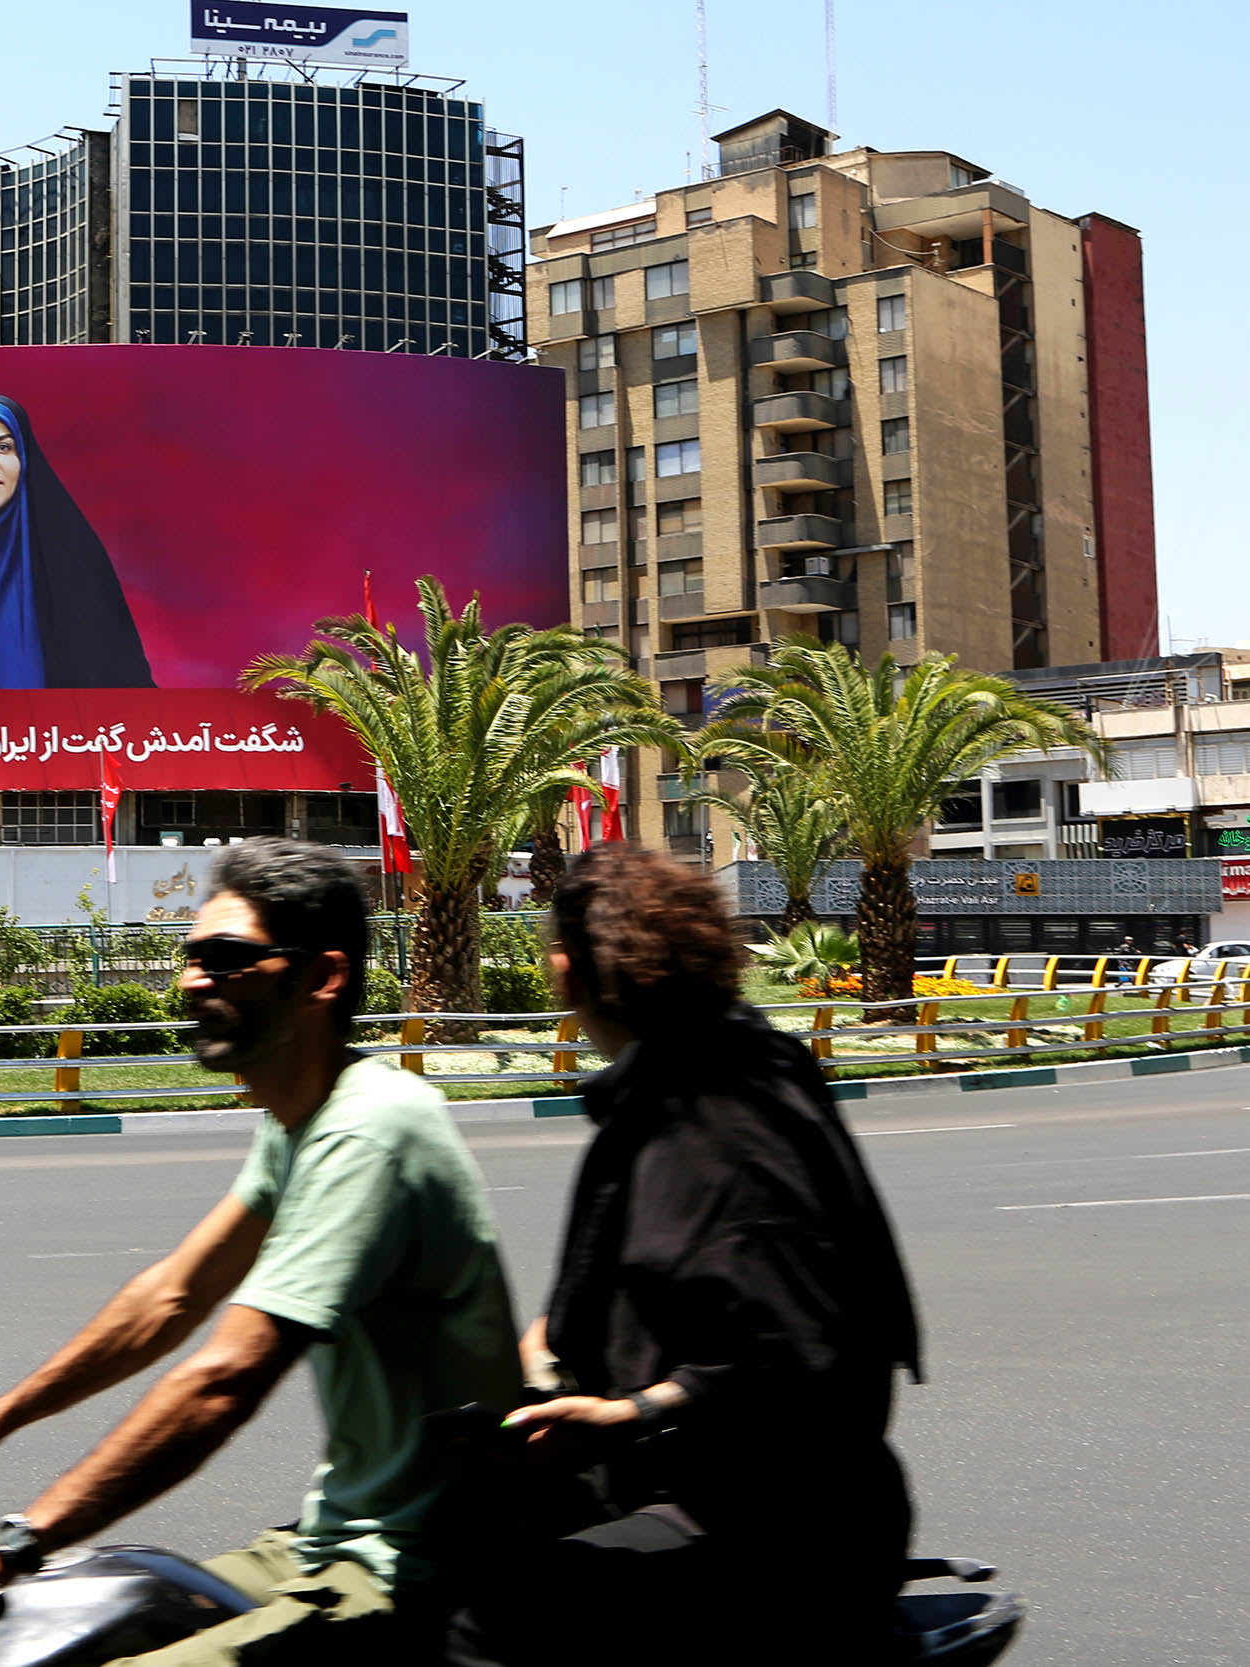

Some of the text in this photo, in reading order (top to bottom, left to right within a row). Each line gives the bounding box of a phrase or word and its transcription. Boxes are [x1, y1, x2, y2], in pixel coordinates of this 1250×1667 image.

[204, 8, 327, 40] بیمه سینا
[38, 726, 59, 762] از
[62, 722, 126, 753] گفت
[126, 721, 213, 762] آمدش
[214, 722, 305, 753] شگفت
